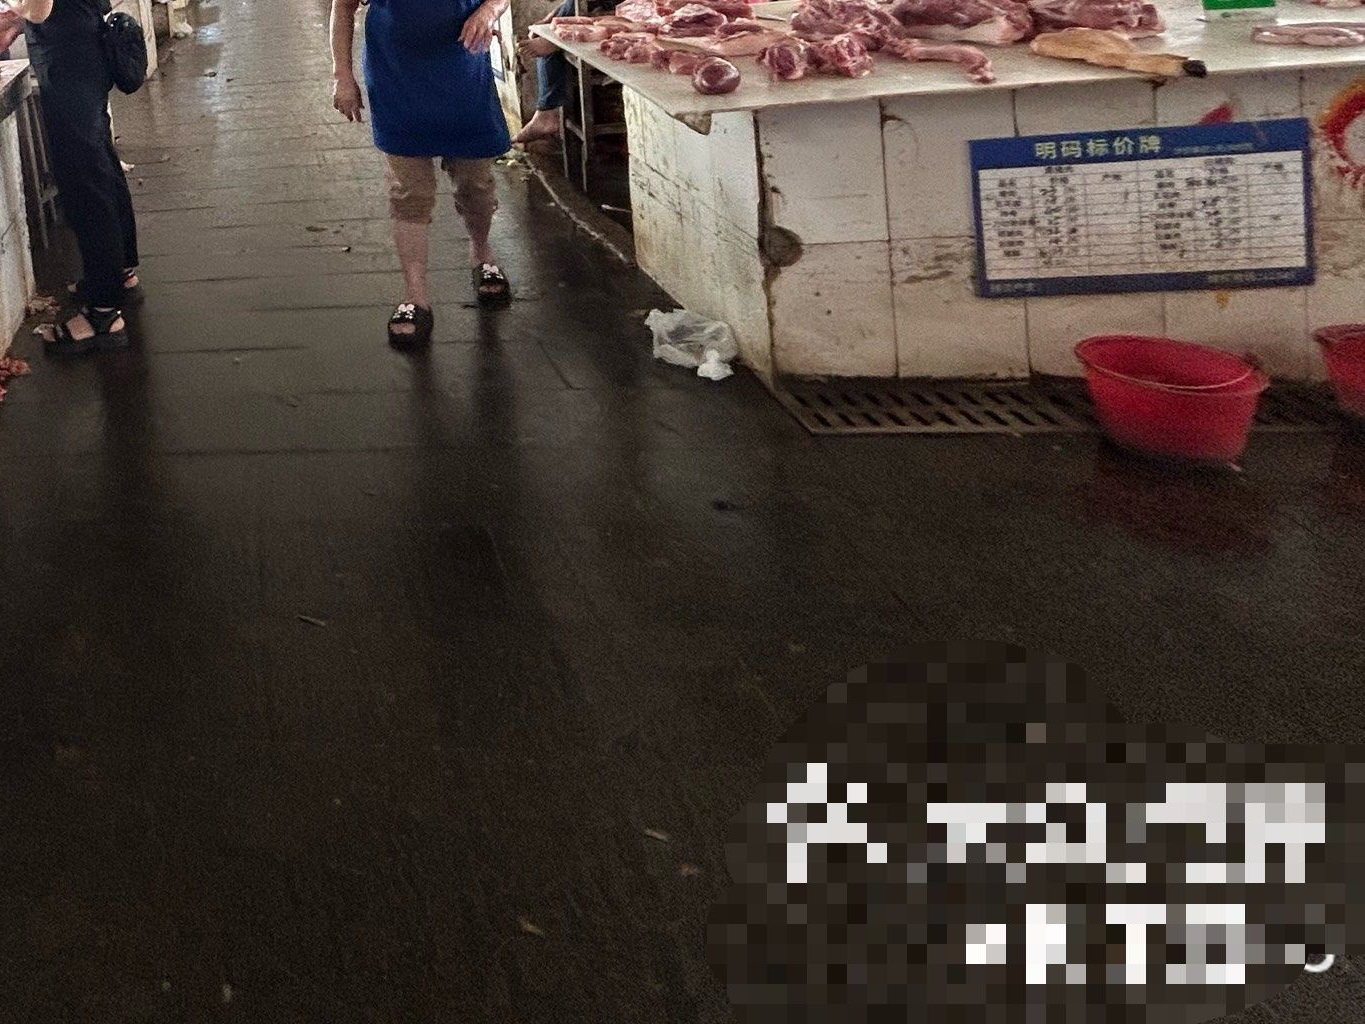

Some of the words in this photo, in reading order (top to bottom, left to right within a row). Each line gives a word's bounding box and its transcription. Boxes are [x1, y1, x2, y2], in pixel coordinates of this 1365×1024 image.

[1034, 135, 1162, 160] 明码标价牌
